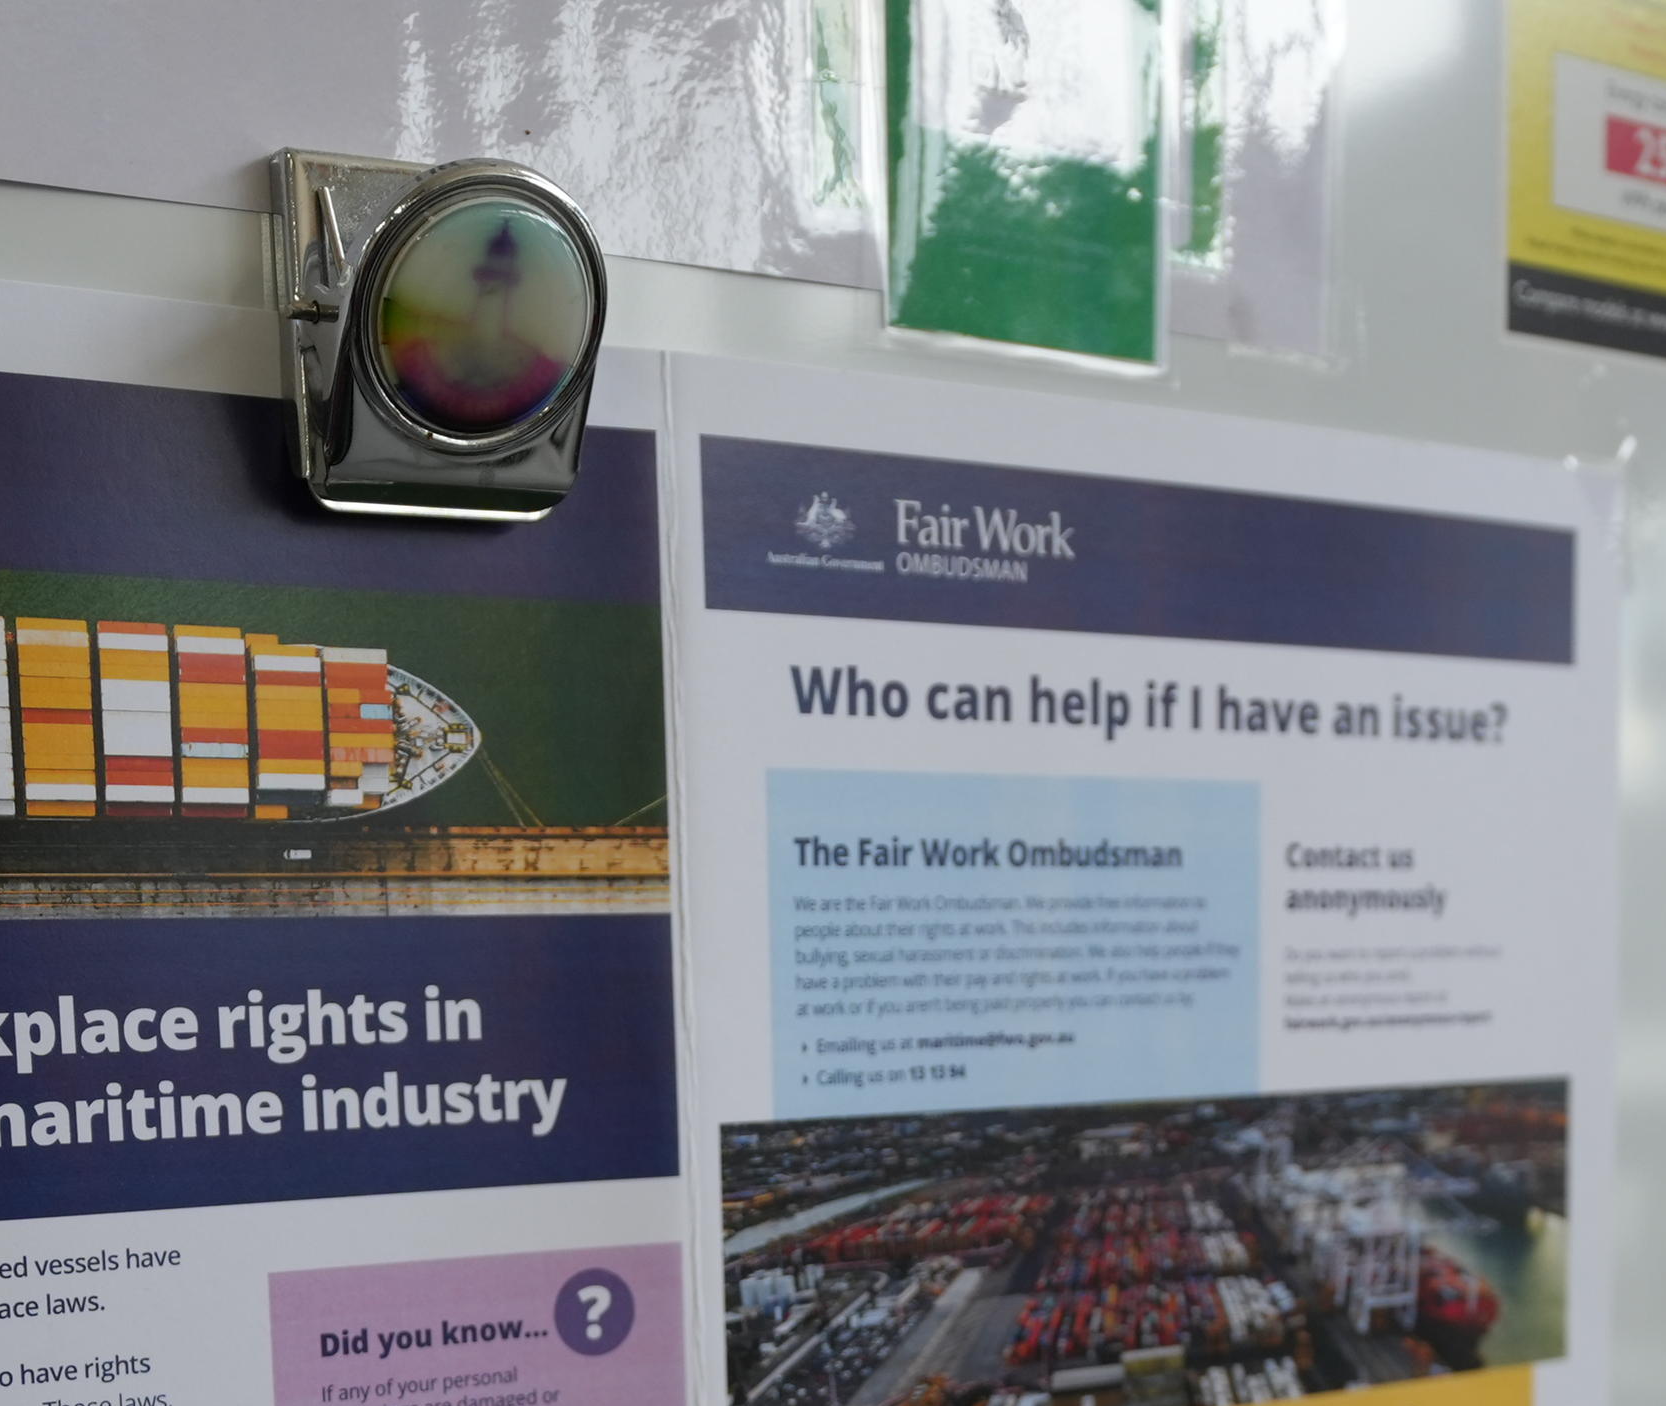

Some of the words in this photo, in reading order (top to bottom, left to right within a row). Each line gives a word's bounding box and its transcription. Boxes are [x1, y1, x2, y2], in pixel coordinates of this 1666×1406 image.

[894, 498, 970, 548] Fair
[974, 506, 1075, 559] Work
[895, 552, 1028, 582] OMBUDSMAN
[792, 666, 908, 718] Who
[927, 684, 1011, 722] can
[1031, 675, 1129, 741] help
[1147, 682, 1176, 729] if
[1193, 687, 1200, 730] I
[1219, 686, 1319, 735] have
[1333, 703, 1379, 736] an
[1394, 703, 1507, 743] issue?
[794, 836, 849, 867] The
[859, 838, 913, 867] Fair
[921, 837, 1000, 868] Work
[1008, 839, 1182, 869] Ombudsman
[1286, 842, 1381, 869] Contact
[1388, 850, 1414, 869] us
[1287, 882, 1447, 920] anonymously
[219, 989, 407, 1064] rights
[426, 986, 482, 1042] in
[303, 1071, 567, 1136] industry
[35, 1250, 119, 1276] vessels
[126, 1247, 180, 1269] have
[47, 1293, 104, 1316] laws.
[320, 1327, 368, 1358] Did
[378, 1328, 432, 1359] you
[442, 1319, 549, 1346] know...
[20, 1363, 77, 1385] have
[85, 1354, 150, 1384] rights
[322, 1384, 333, 1403] If
[339, 1385, 370, 1403] any
[375, 1377, 393, 1397] of
[398, 1377, 437, 1400] your
[443, 1365, 517, 1395] personal
[542, 1389, 560, 1405] or
